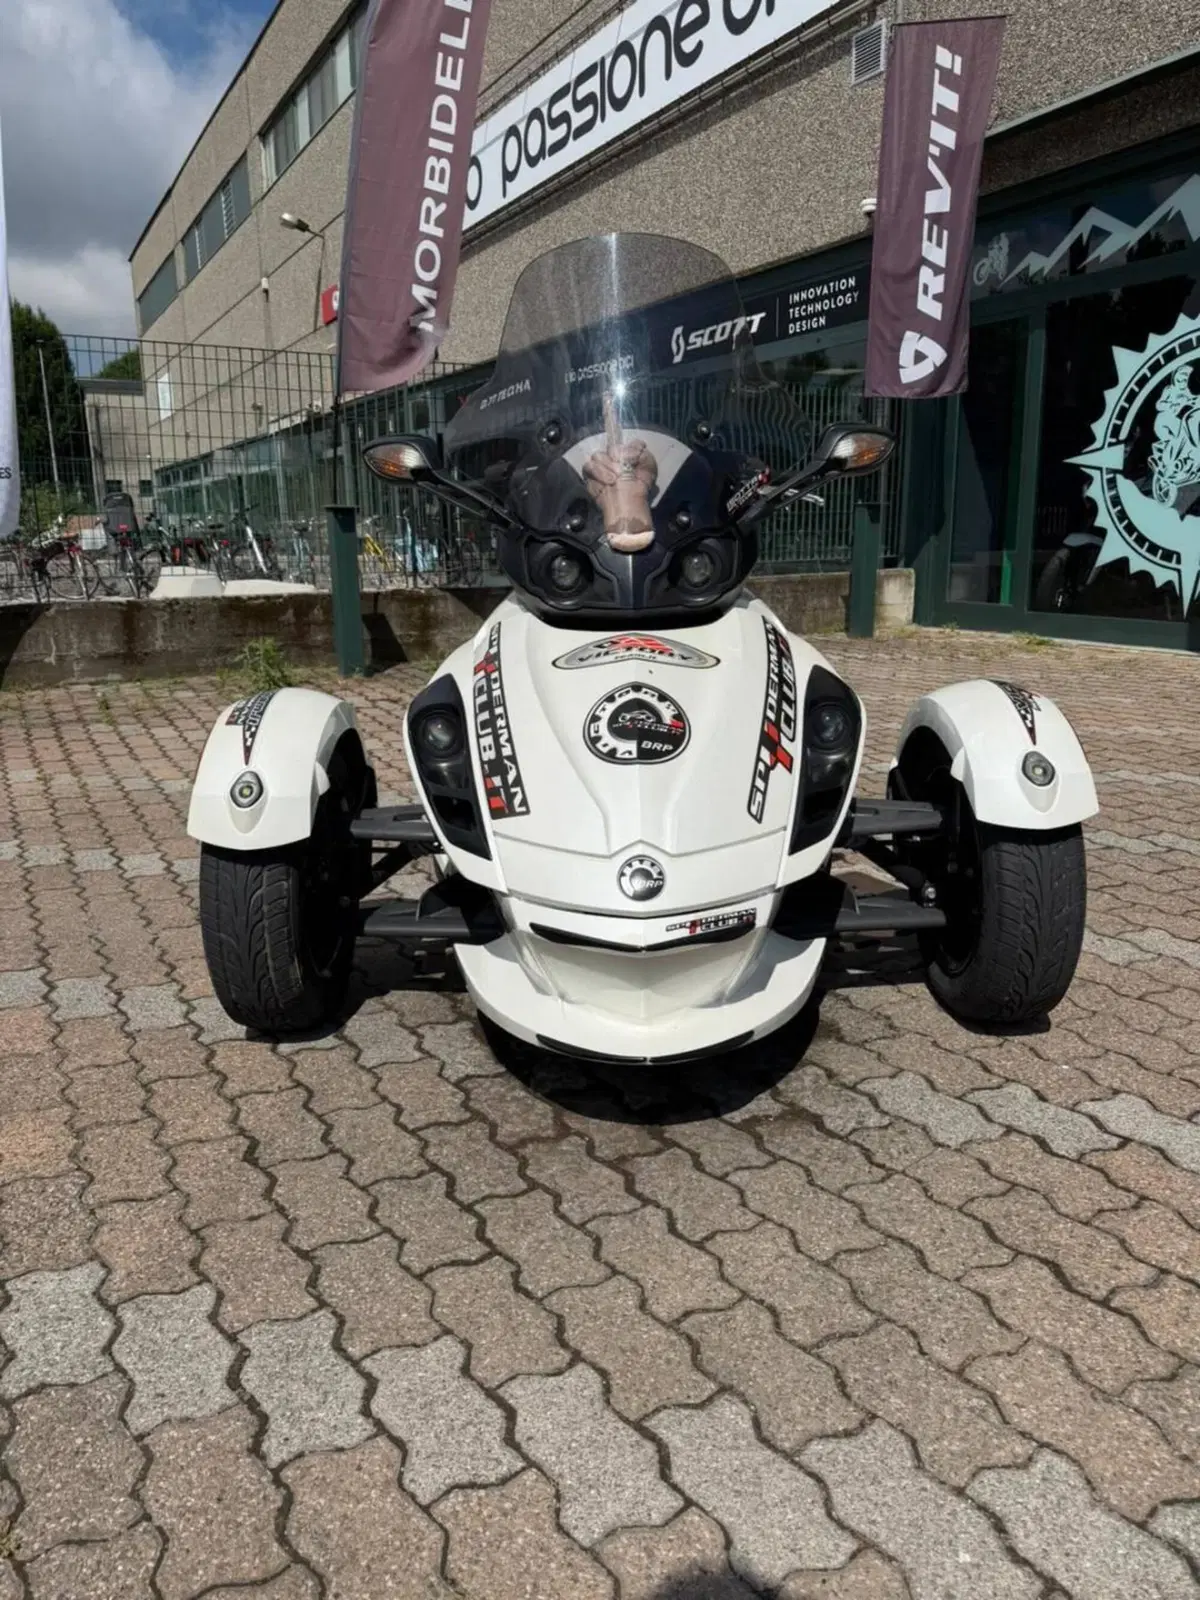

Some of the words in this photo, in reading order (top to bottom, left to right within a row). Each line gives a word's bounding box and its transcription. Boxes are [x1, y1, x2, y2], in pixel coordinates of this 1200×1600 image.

[501, 0, 710, 198] passione
[917, 44, 962, 321] REV'IT!
[789, 276, 856, 304] INNOVATION
[788, 291, 860, 319] TECHNOLOGY
[686, 312, 767, 350] SCOTT
[788, 316, 826, 334] DESIGN
[641, 740, 674, 752] BRP
